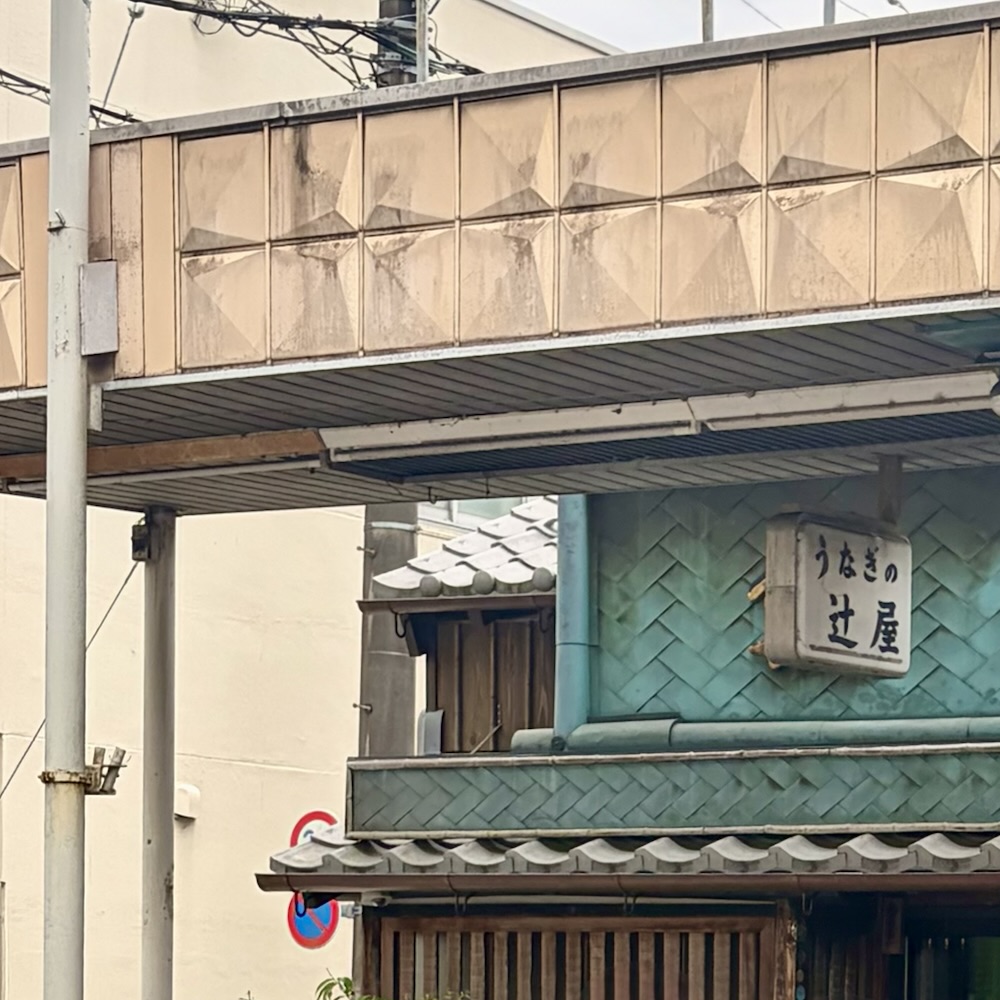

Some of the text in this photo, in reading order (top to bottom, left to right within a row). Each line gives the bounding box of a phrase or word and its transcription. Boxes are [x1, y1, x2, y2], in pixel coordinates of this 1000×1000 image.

[815, 534, 898, 583] うなぎの
[828, 593, 900, 655] 辻屋
